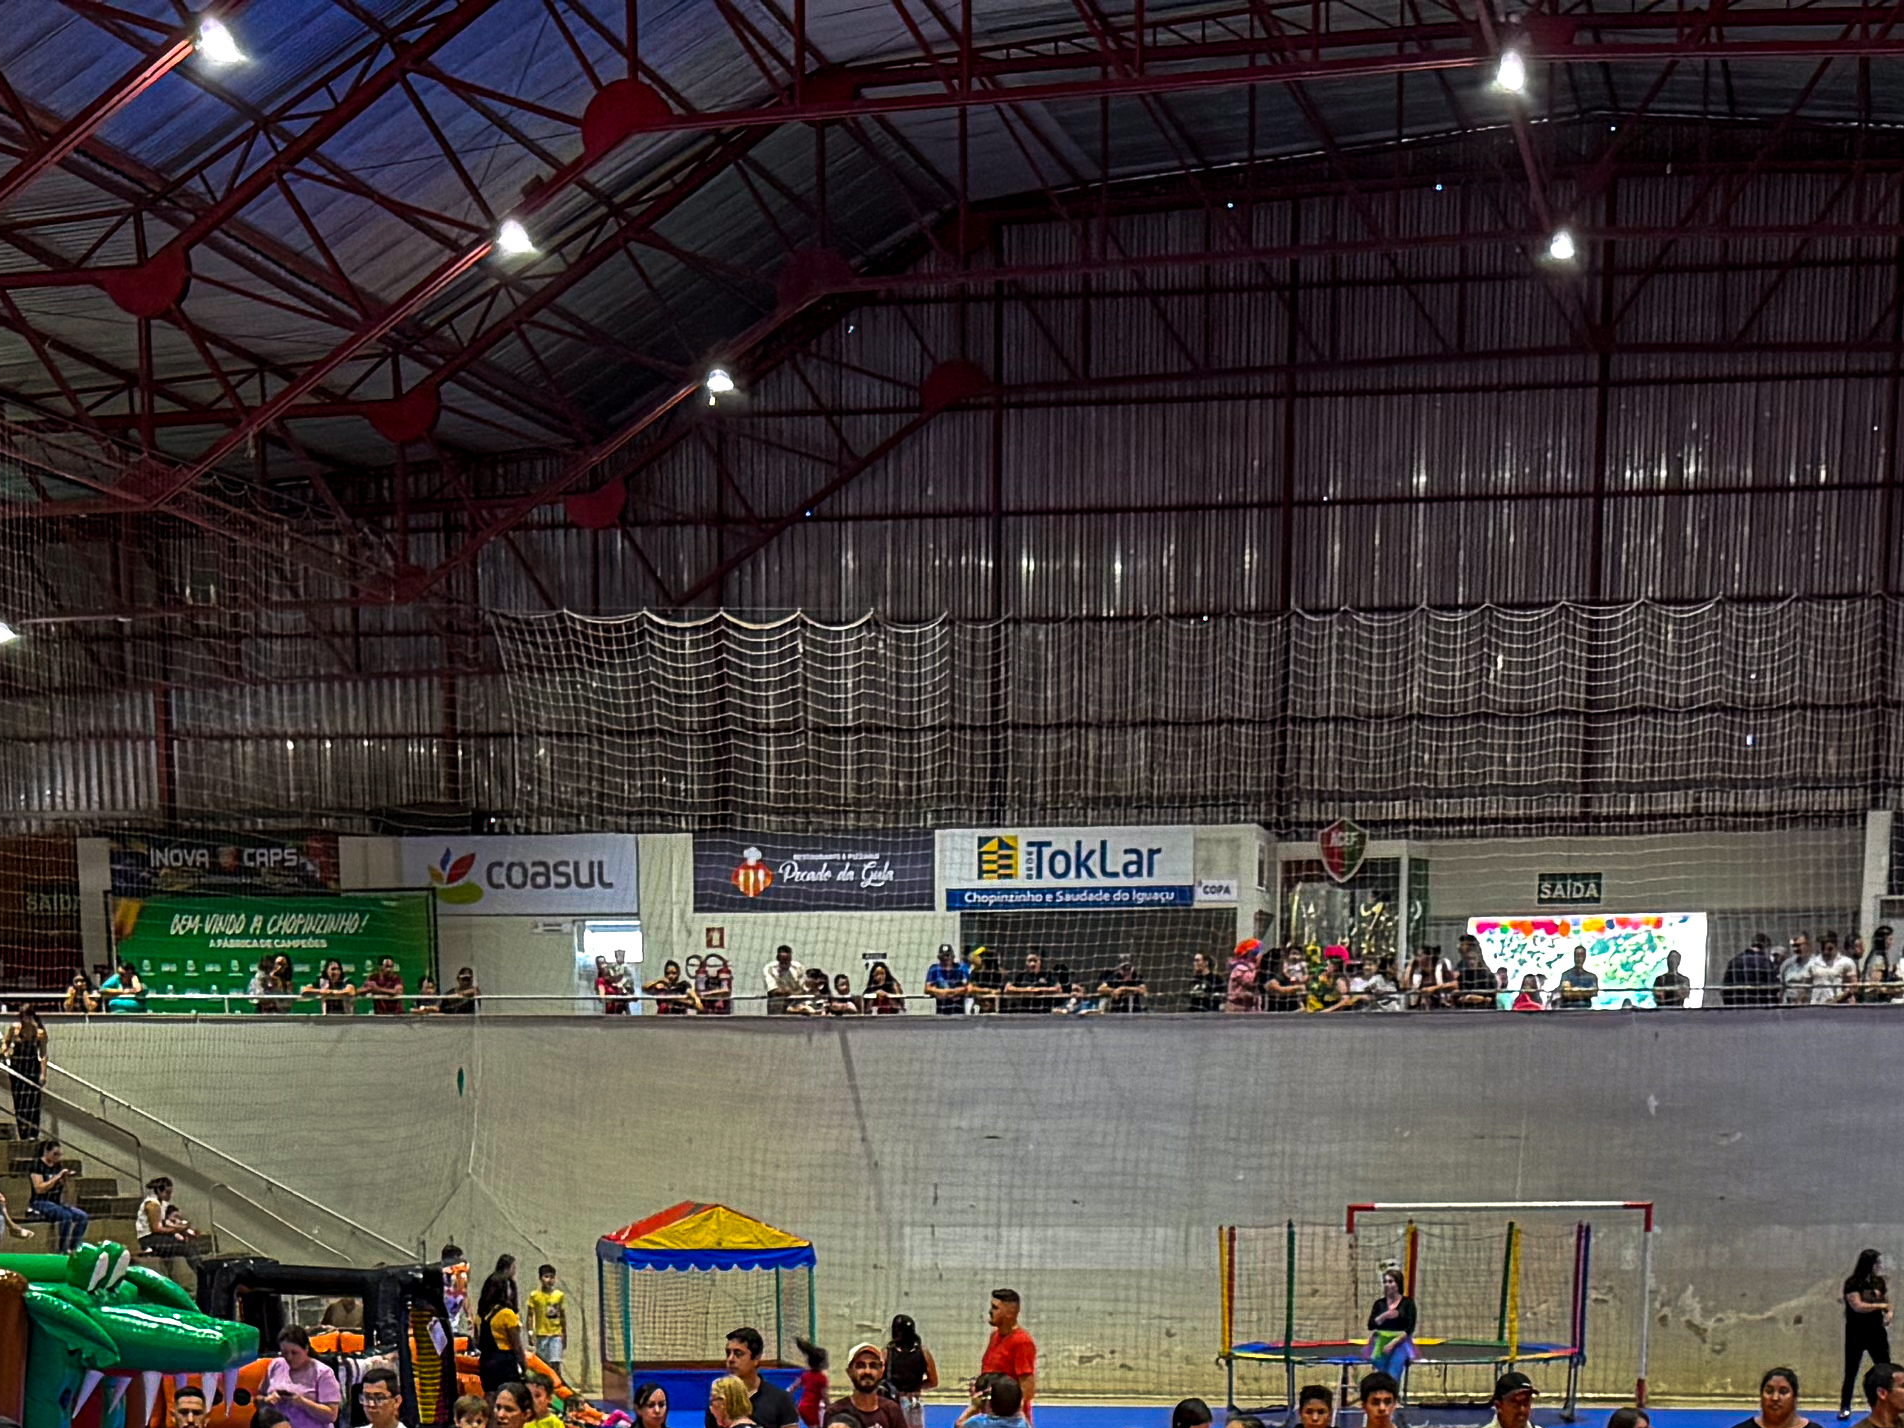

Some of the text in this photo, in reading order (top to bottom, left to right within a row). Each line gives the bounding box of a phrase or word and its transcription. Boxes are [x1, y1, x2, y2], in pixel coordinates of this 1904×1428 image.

[150, 848, 297, 868] INOVA CAPS
[1026, 839, 1162, 879] TokLar
[486, 860, 614, 889] coasul
[860, 861, 894, 888] Gula
[964, 890, 1175, 906] Chopinzinho e Saudade do Iguaçu
[1202, 884, 1232, 896] COPA
[1539, 879, 1600, 899] SAÍDA
[170, 913, 246, 935] BEM-VINDO
[267, 912, 370, 935] CHOPINZINHO!
